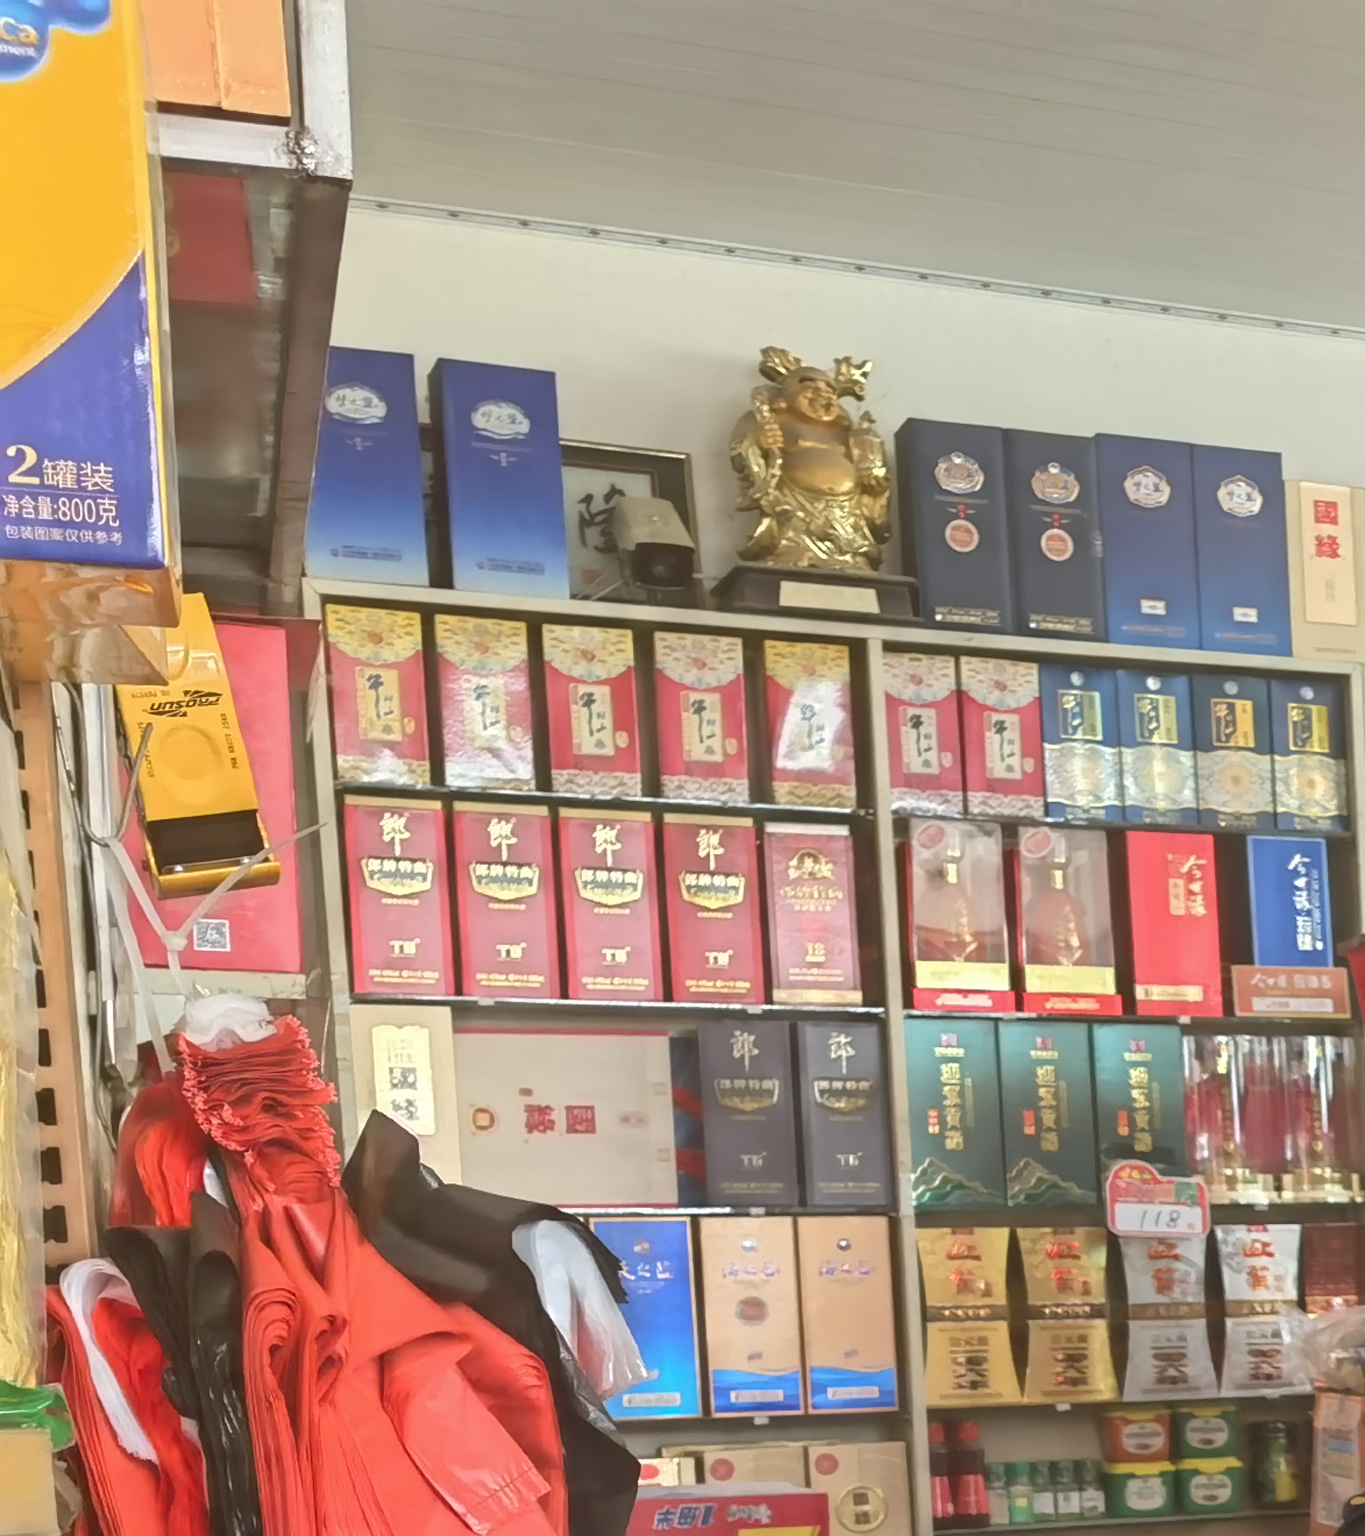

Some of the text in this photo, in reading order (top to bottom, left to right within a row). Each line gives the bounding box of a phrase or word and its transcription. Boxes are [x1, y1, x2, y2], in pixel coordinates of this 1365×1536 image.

[6, 444, 115, 492] 2罐装
[2, 494, 120, 527] 净含量:800克
[1139, 1208, 1182, 1230] 118
